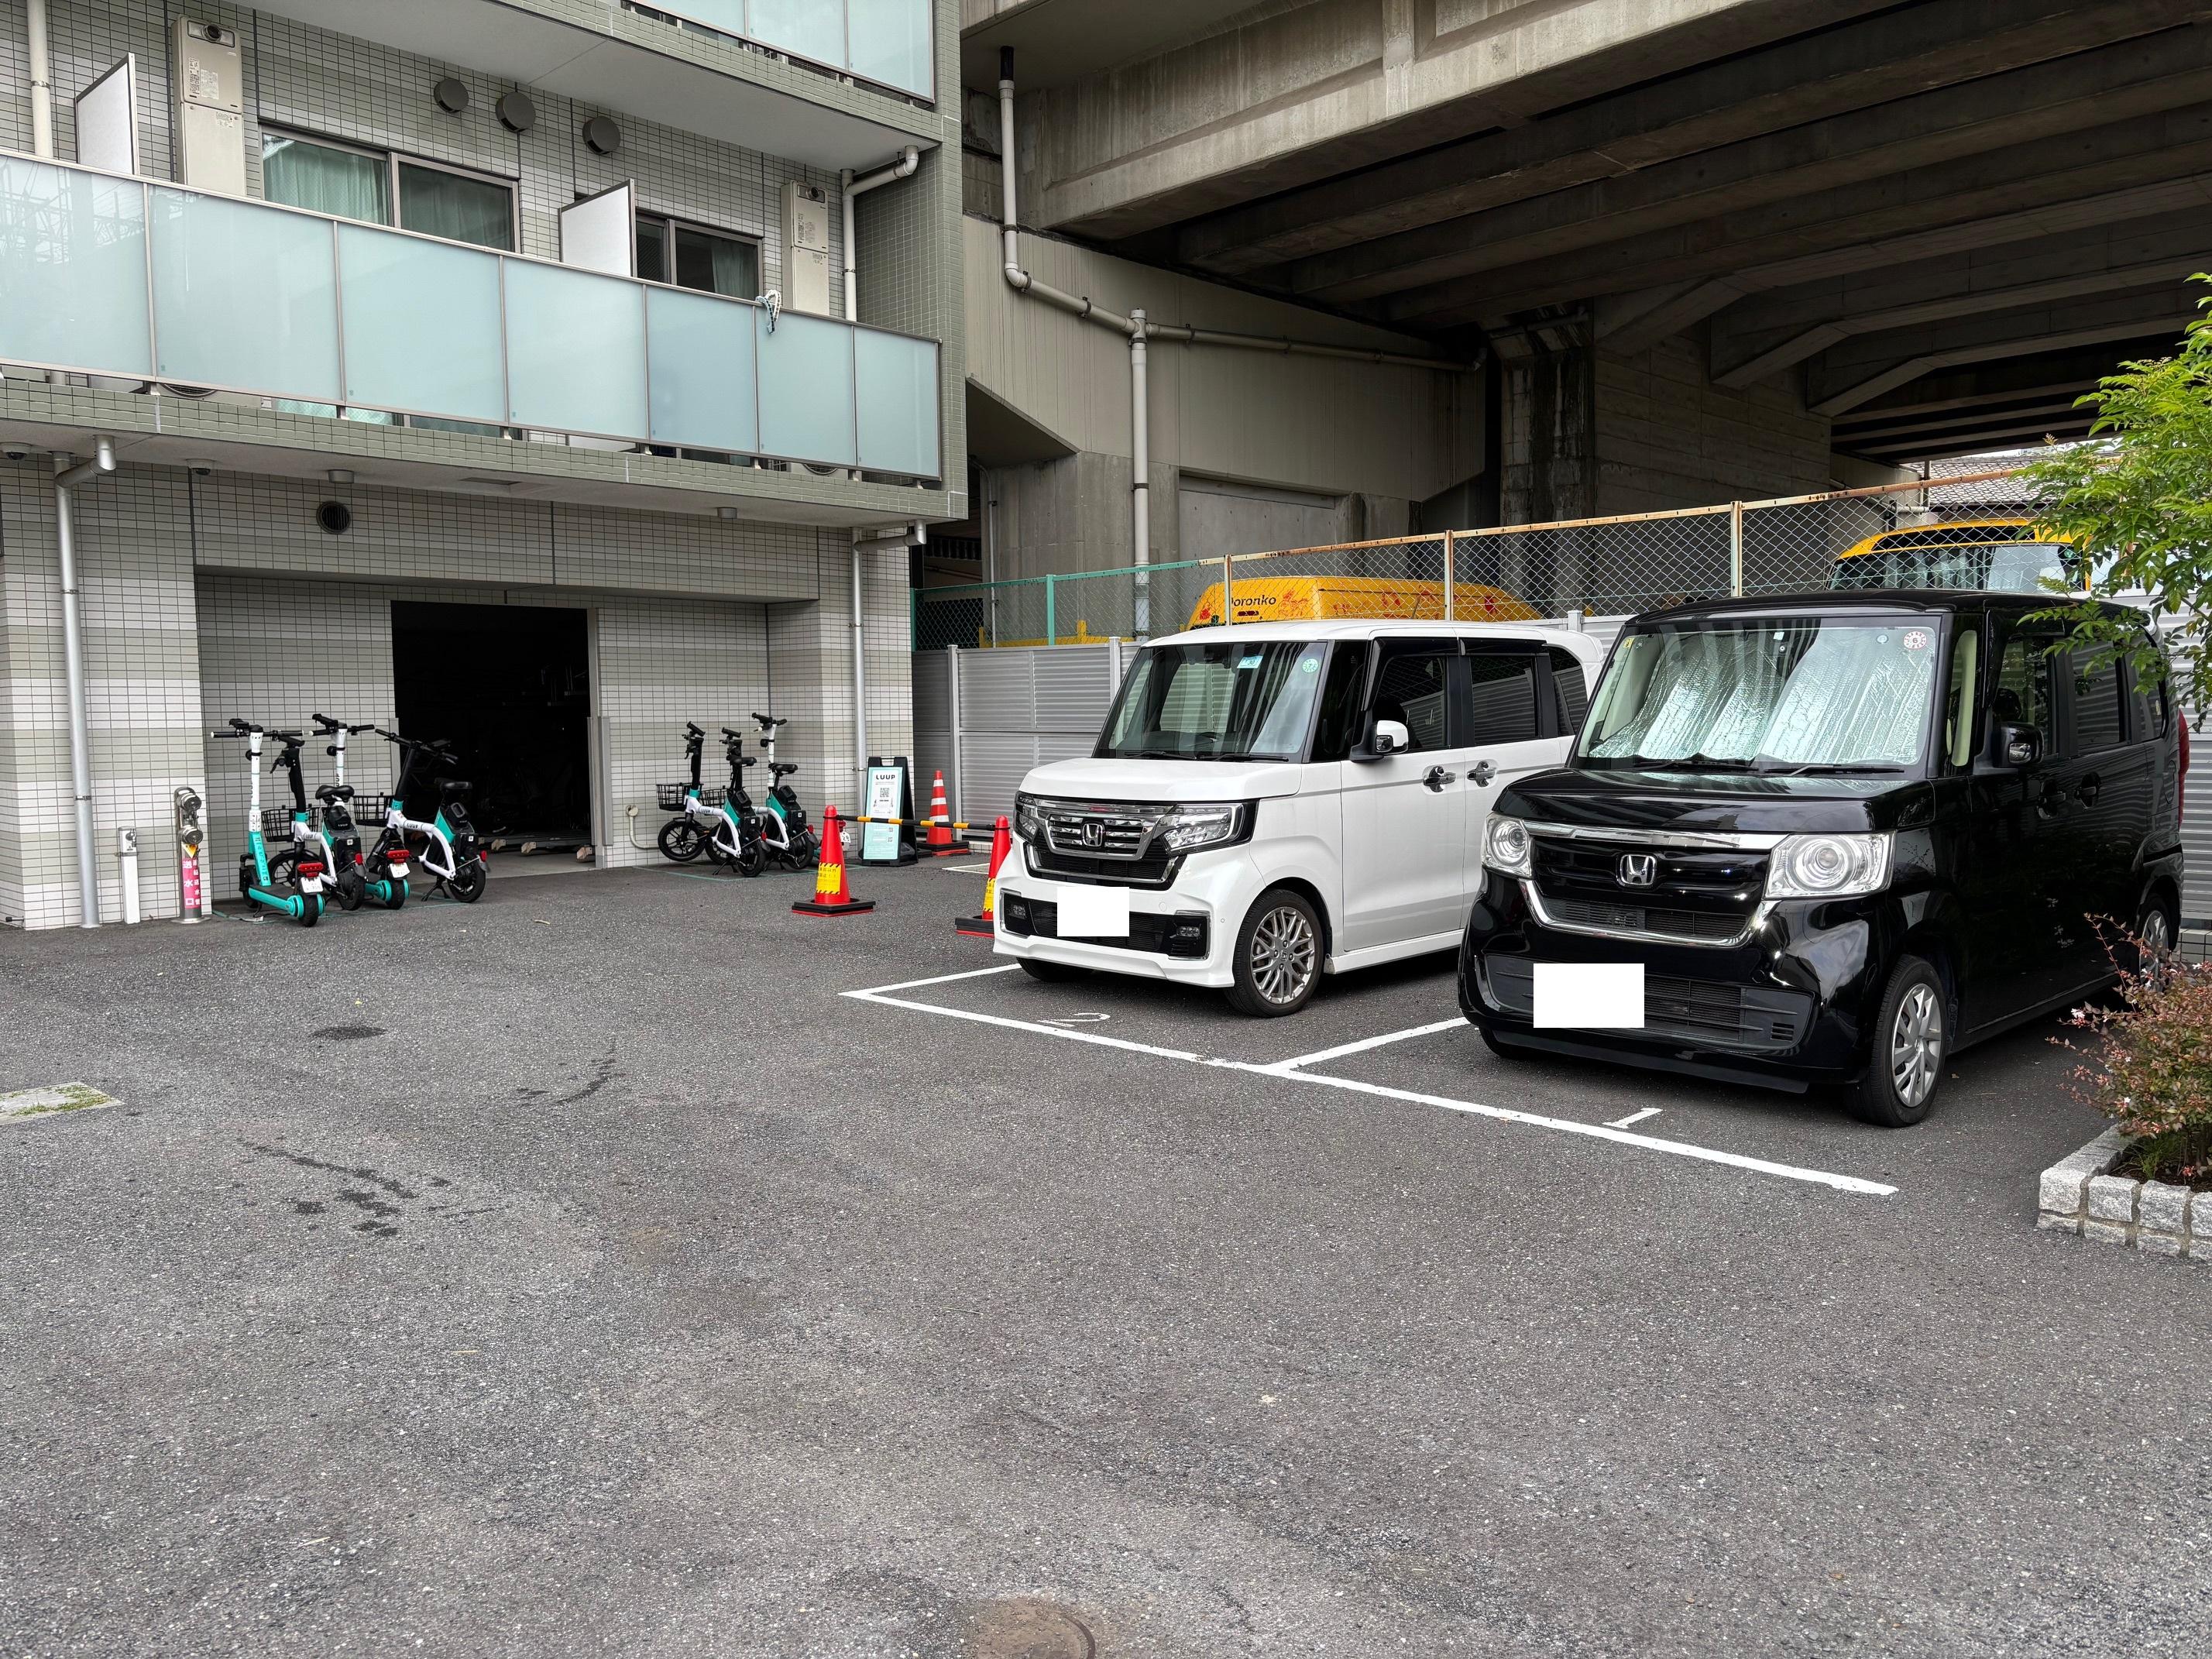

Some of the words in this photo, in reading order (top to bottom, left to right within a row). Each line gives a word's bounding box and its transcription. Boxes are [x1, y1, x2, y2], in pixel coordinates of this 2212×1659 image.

[1231, 595, 1276, 606] oronko
[182, 860, 194, 905] 送水口
[1036, 1012, 1111, 1027] 2
[1602, 1107, 1663, 1128] 1
